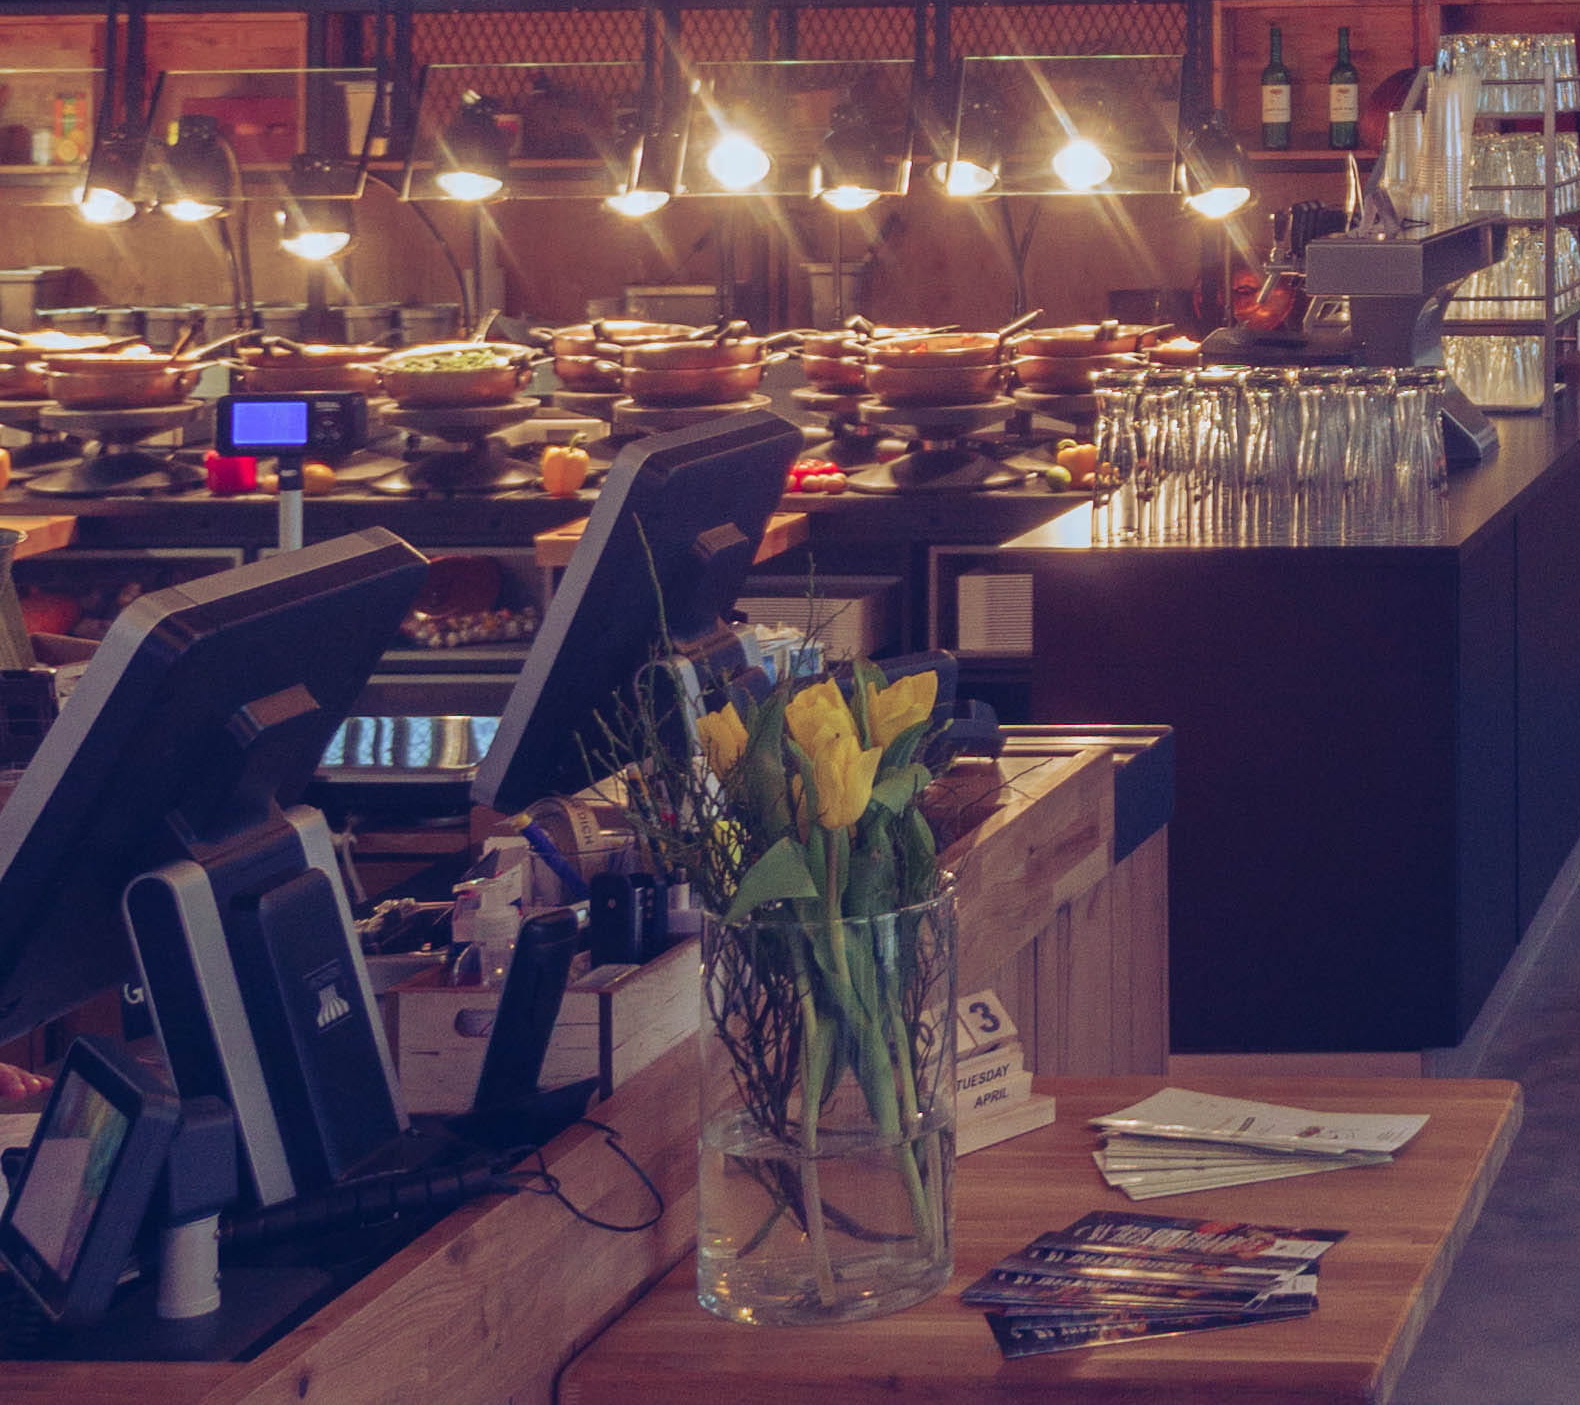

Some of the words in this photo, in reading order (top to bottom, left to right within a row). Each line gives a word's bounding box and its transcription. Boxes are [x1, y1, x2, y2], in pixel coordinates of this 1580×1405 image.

[968, 1001, 1001, 1033] 3
[955, 1063, 1010, 1093] TUESDAY
[973, 1087, 1010, 1109] APRIL
